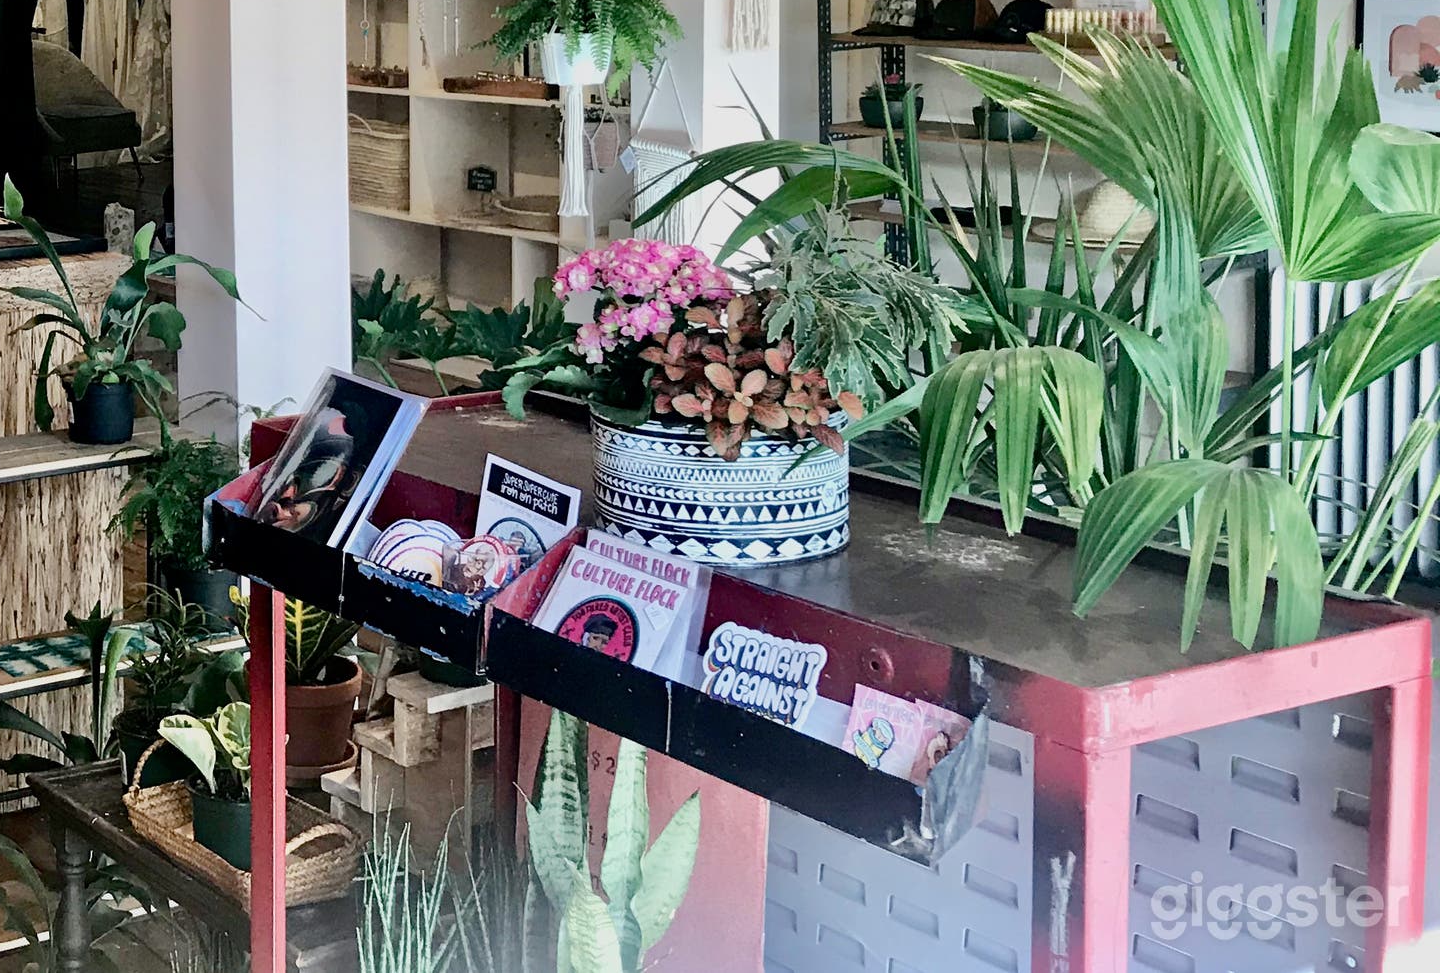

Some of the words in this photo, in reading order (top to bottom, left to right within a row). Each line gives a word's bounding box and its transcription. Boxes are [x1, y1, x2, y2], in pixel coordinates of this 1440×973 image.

[532, 497, 558, 515] patch
[571, 559, 636, 596] CULTURE
[634, 580, 681, 611] FLOCK
[589, 539, 649, 572] CULTURE
[651, 558, 691, 586] FLOCK
[715, 629, 820, 684] STRAIGHT
[713, 665, 809, 719] AGAINST
